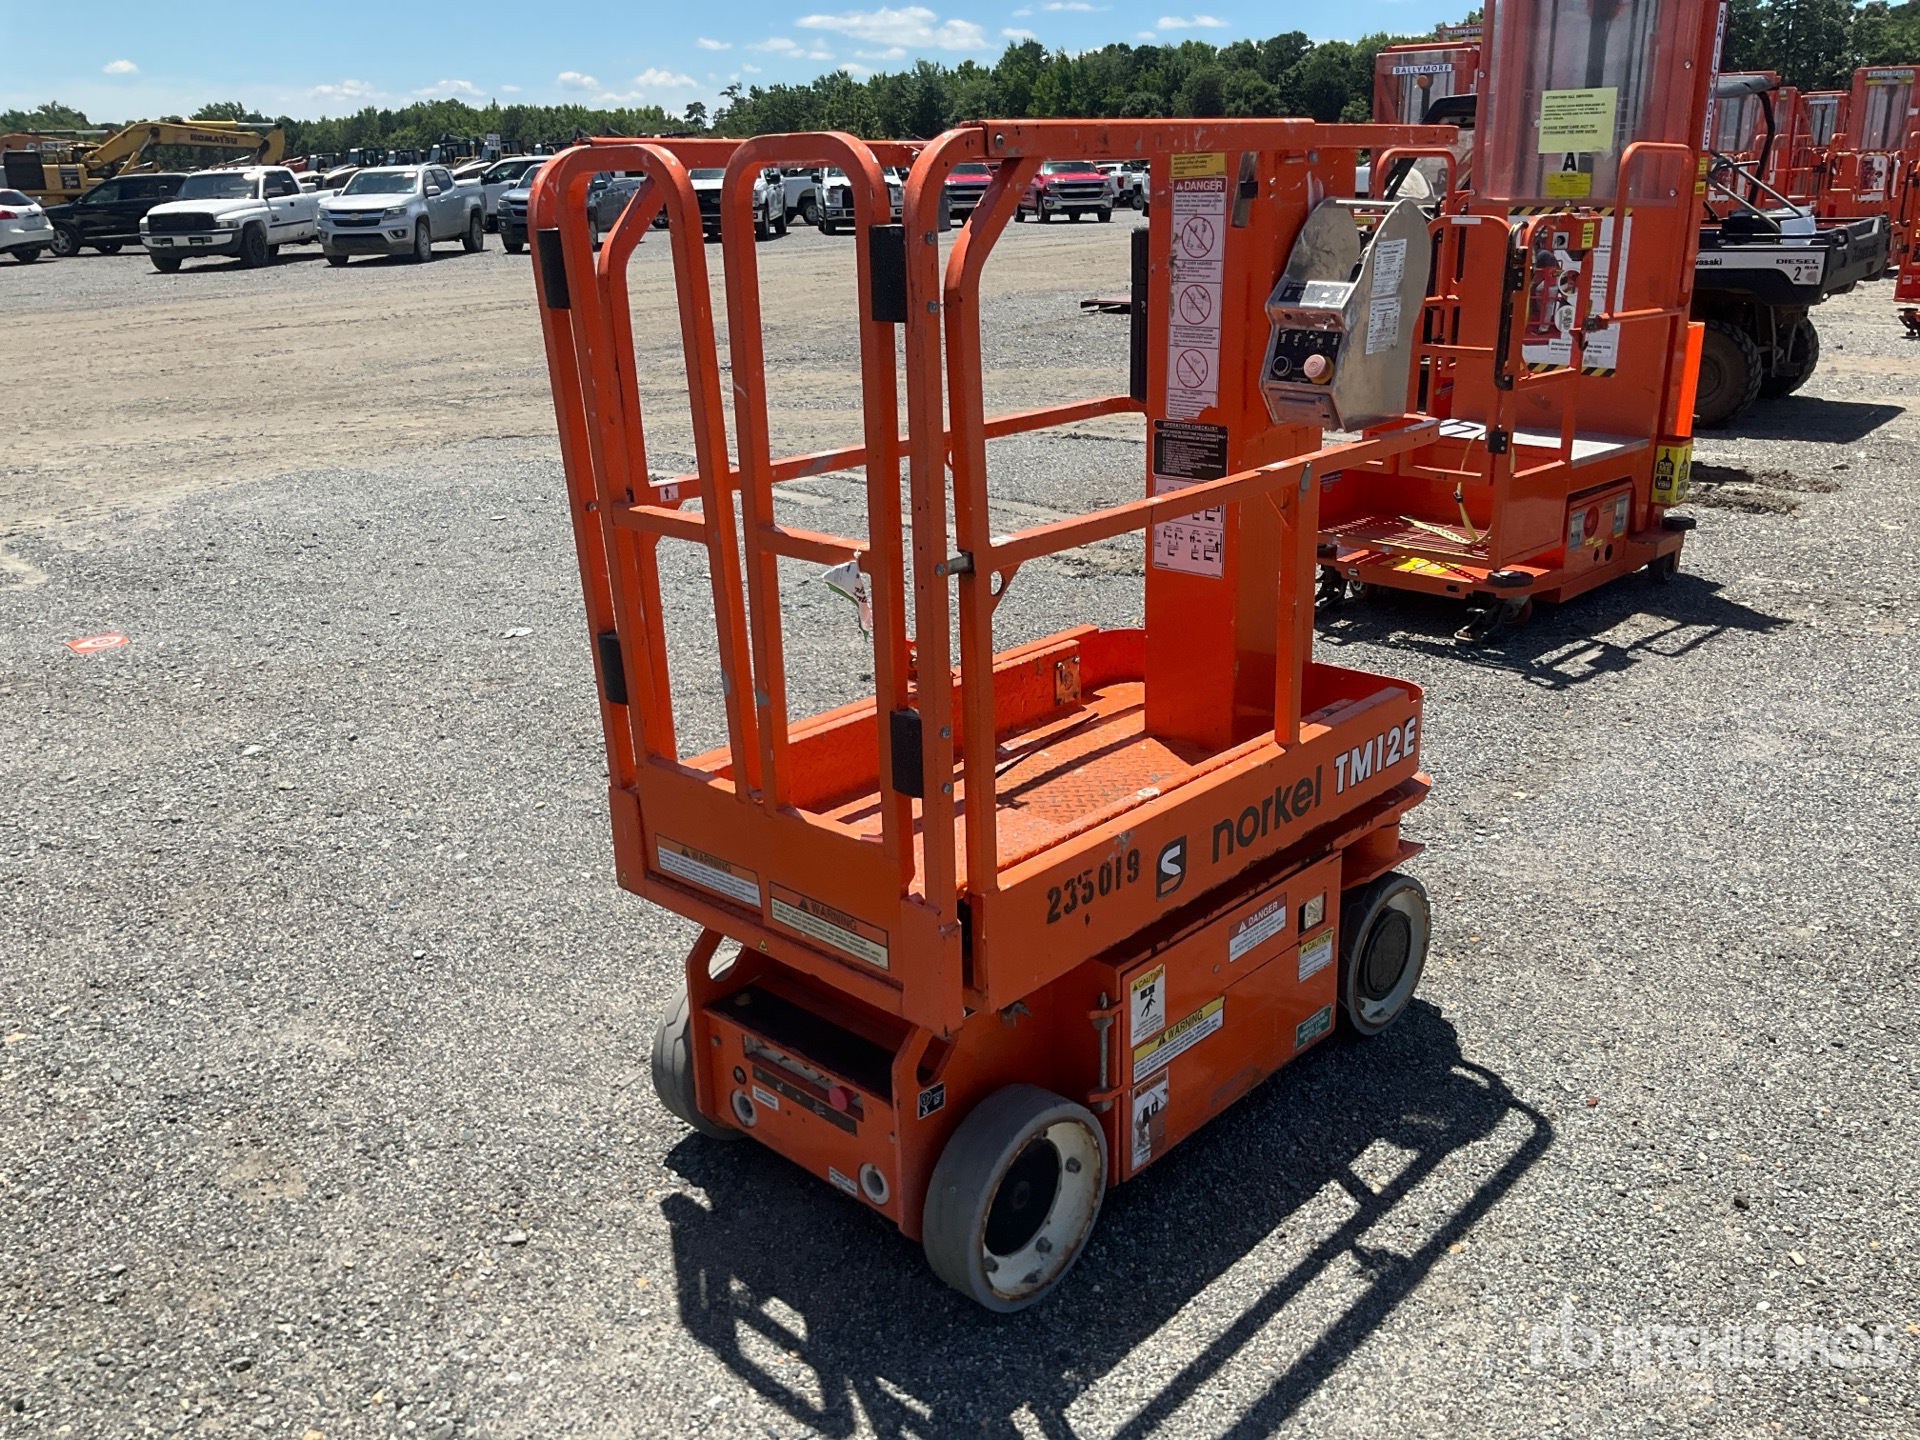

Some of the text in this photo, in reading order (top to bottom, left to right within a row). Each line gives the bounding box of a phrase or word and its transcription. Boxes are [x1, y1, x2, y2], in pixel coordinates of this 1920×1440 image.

[1395, 65, 1449, 74] BALLYMORE
[189, 134, 238, 145] KOMATSU
[1562, 152, 1577, 171] A
[1184, 181, 1223, 191] DANGER
[1793, 266, 1802, 282] 2
[1334, 716, 1417, 794] TM12E
[1046, 848, 1141, 924] 235019
[811, 900, 858, 931] WARNING
[1248, 901, 1278, 924] DANGER
[1138, 966, 1164, 988] CAUTION
[1167, 1010, 1204, 1040] WARNING
